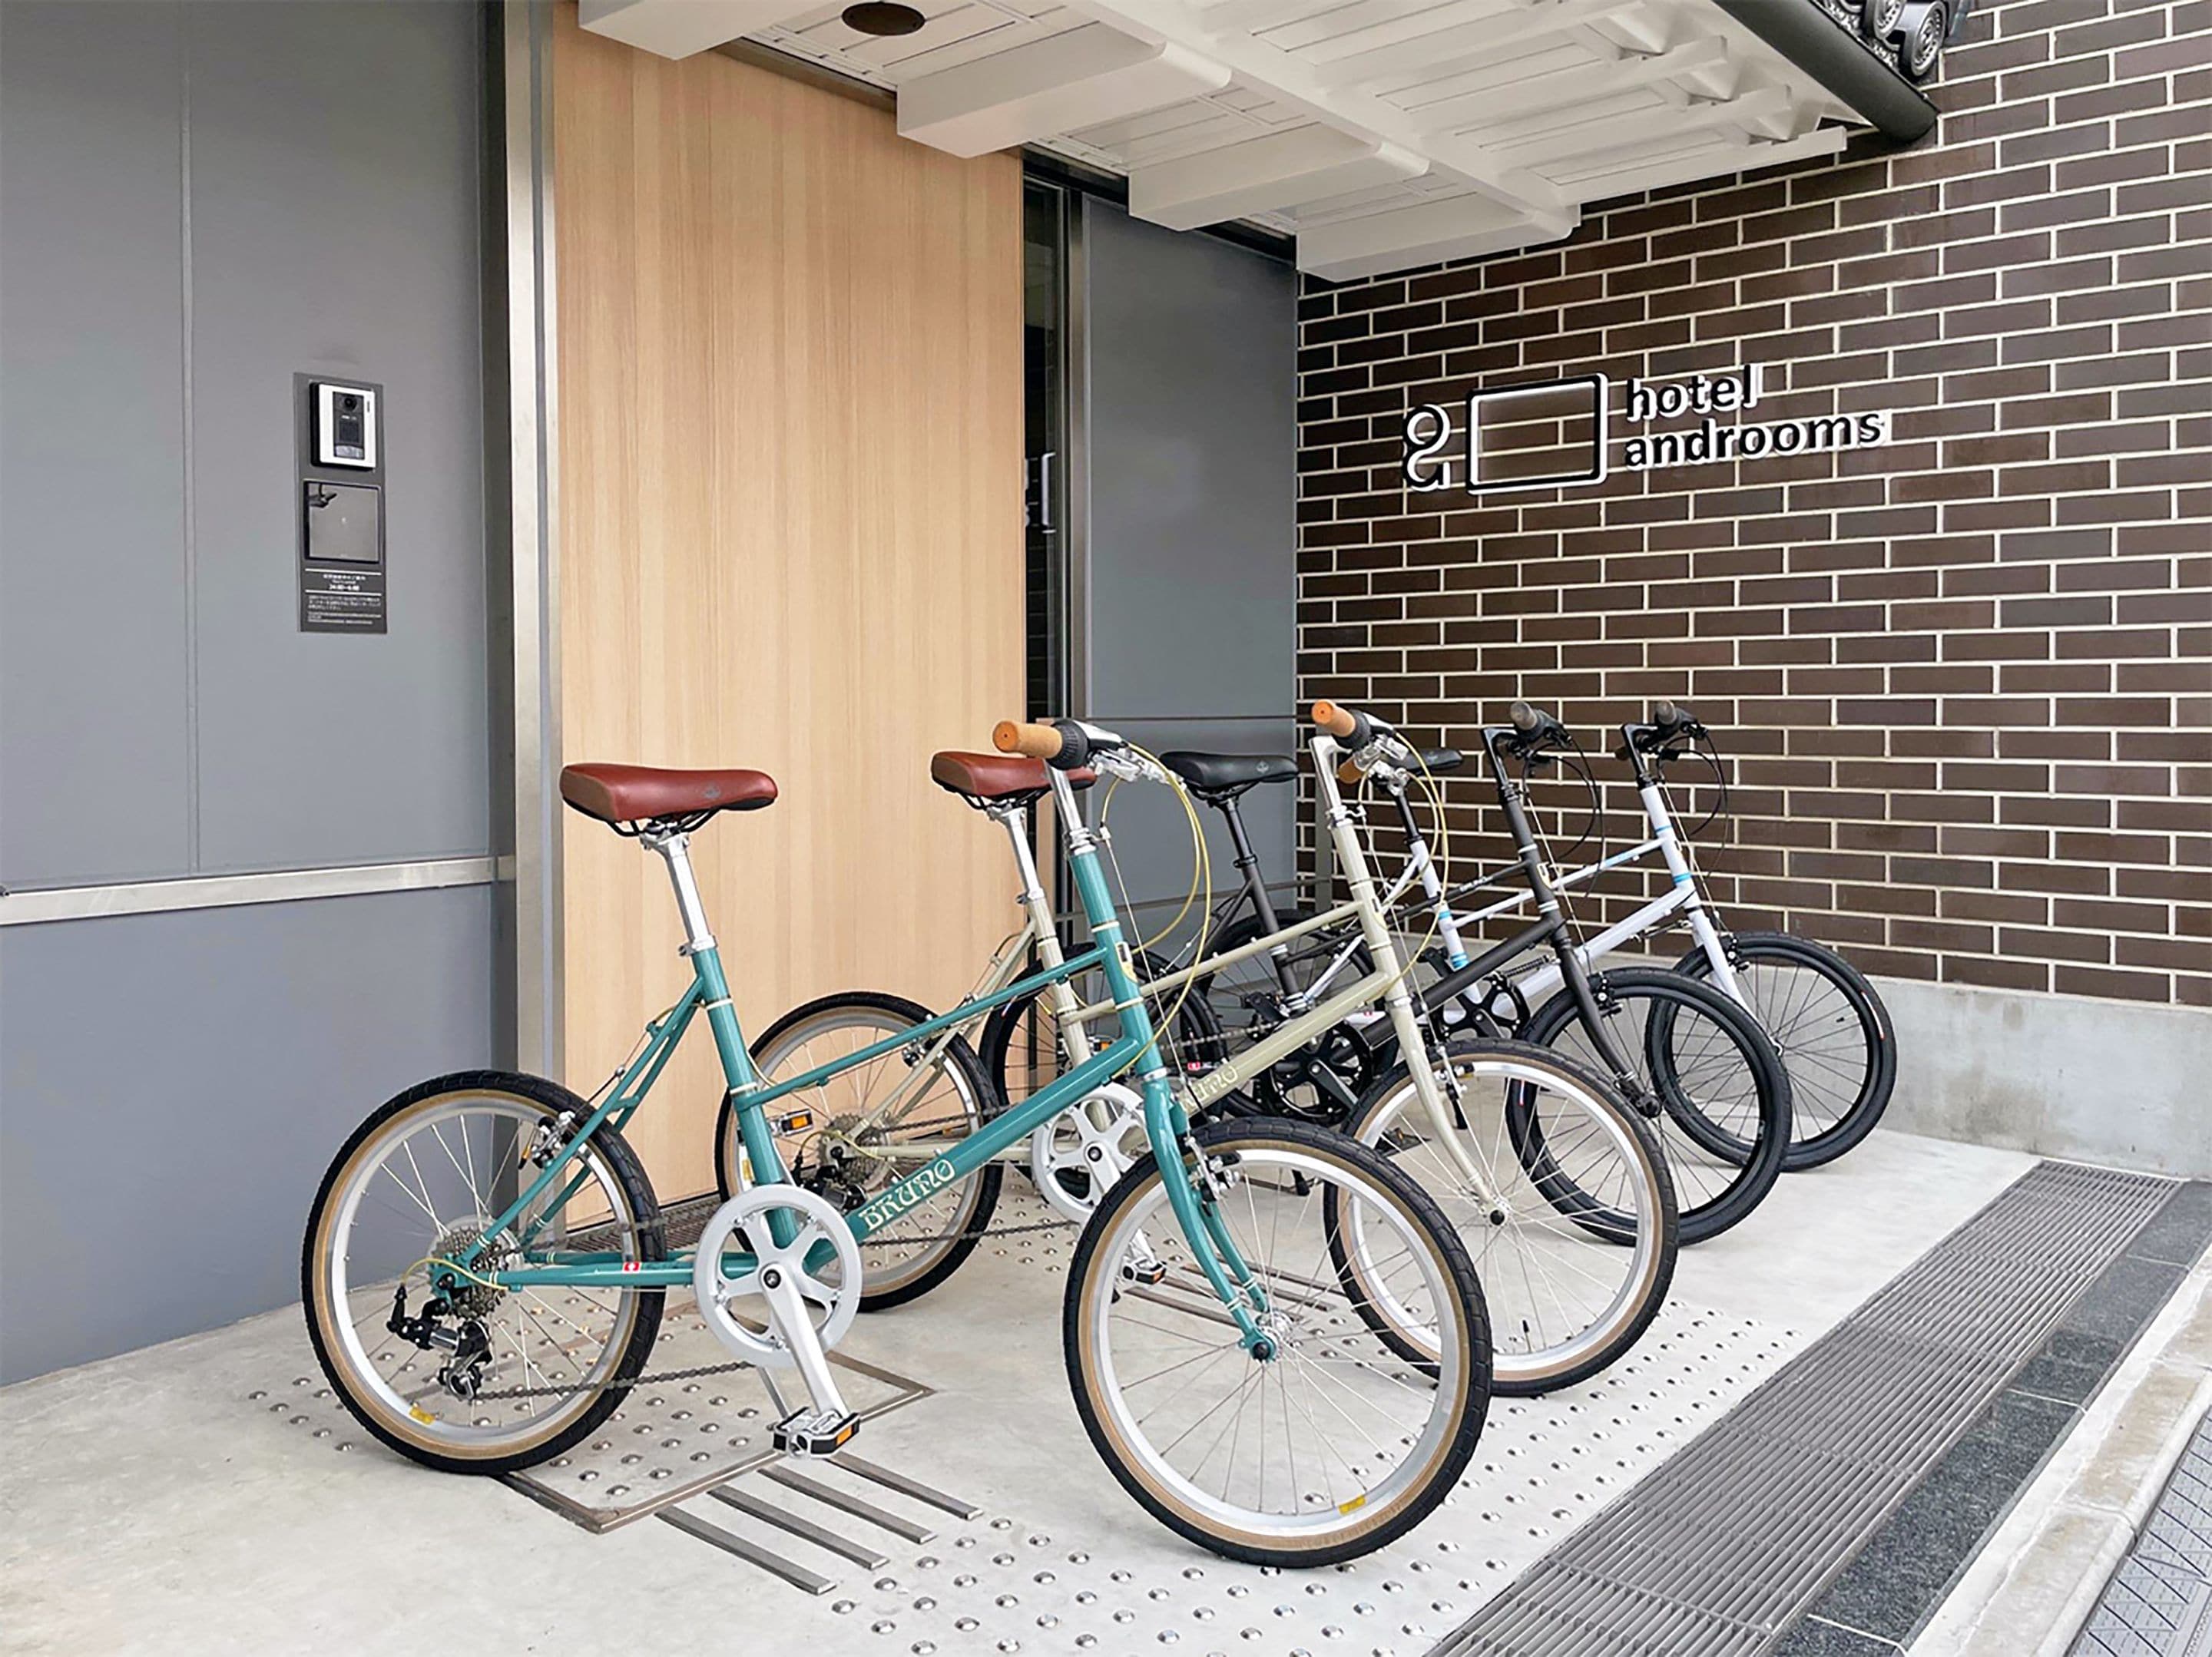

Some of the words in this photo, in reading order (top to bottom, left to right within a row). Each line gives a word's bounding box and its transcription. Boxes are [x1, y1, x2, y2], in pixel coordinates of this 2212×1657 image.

[1626, 364, 1754, 420] hotel
[1625, 413, 1883, 468] androoms
[858, 1159, 955, 1230] BRUNO
